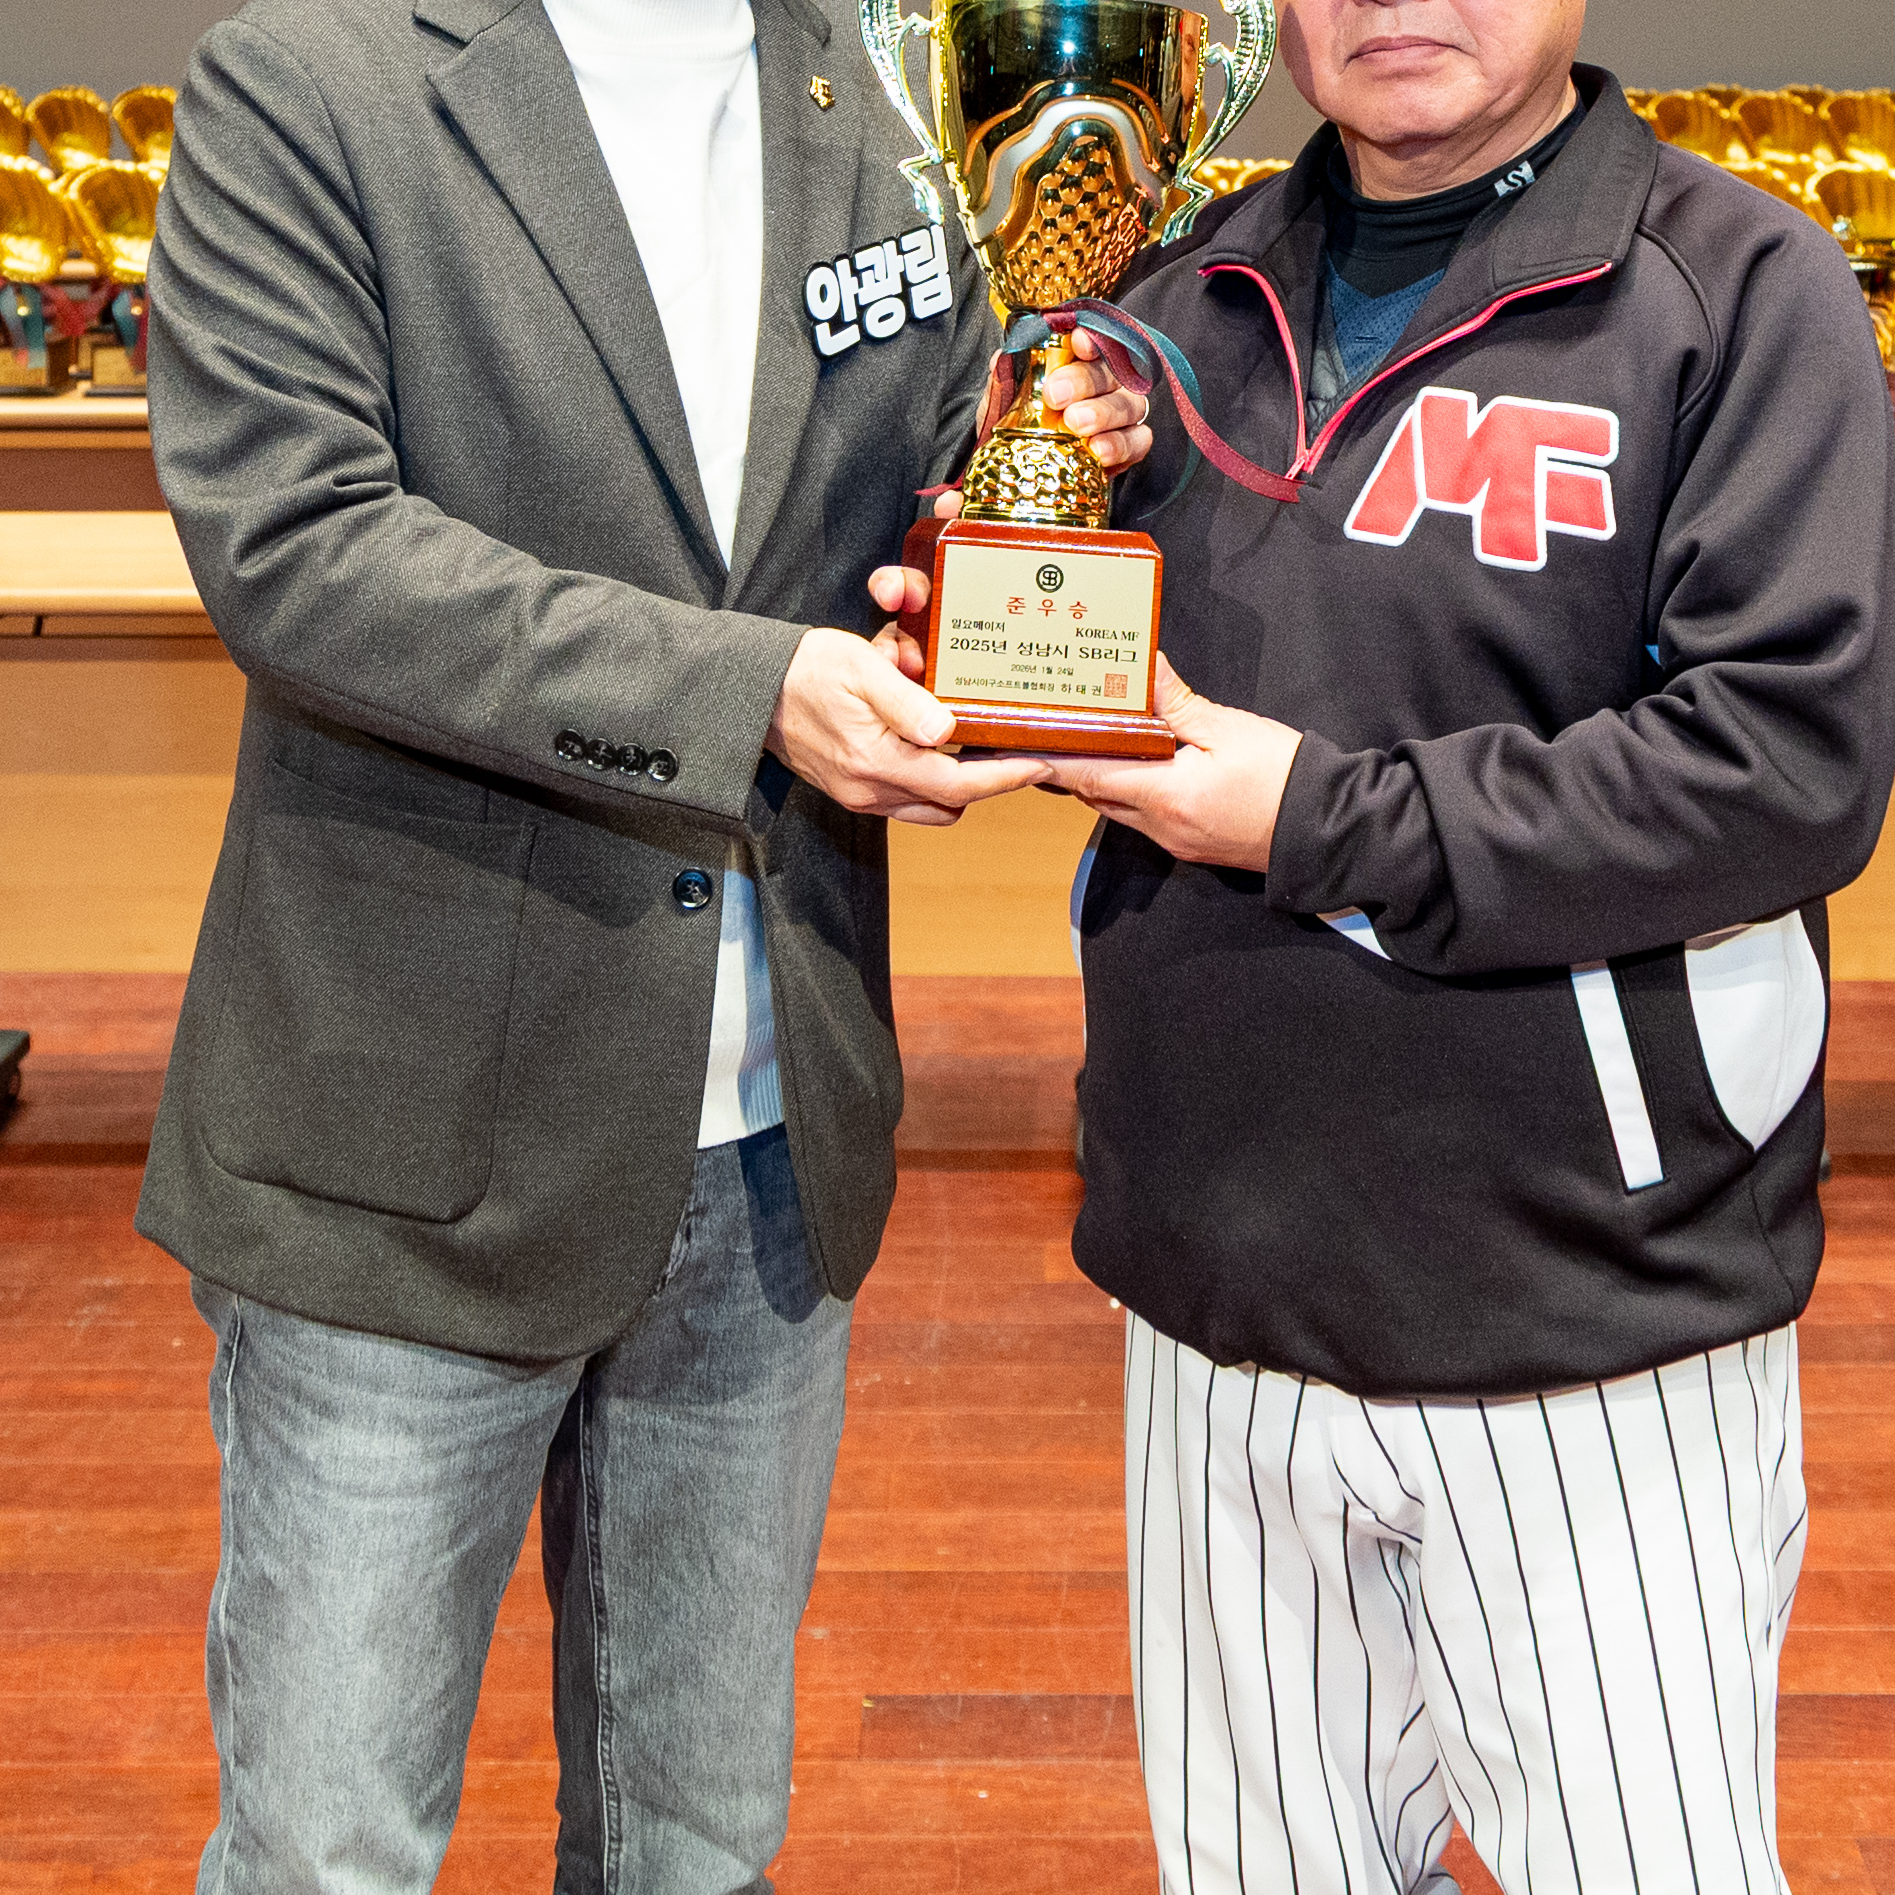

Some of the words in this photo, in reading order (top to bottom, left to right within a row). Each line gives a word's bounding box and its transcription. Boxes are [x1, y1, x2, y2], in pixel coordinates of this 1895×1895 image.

[804, 223, 954, 357] 안광림
[951, 618, 1006, 633] 일요메이저
[1075, 627, 1118, 641] KOREA
[1121, 630, 1141, 643] MF
[950, 637, 1008, 655] 2025년
[1017, 641, 1070, 659] 성남시
[1078, 646, 1139, 663] SB리그
[1010, 663, 1038, 674] 2026년
[1041, 665, 1054, 675] 1월
[1056, 666, 1075, 677] 24일
